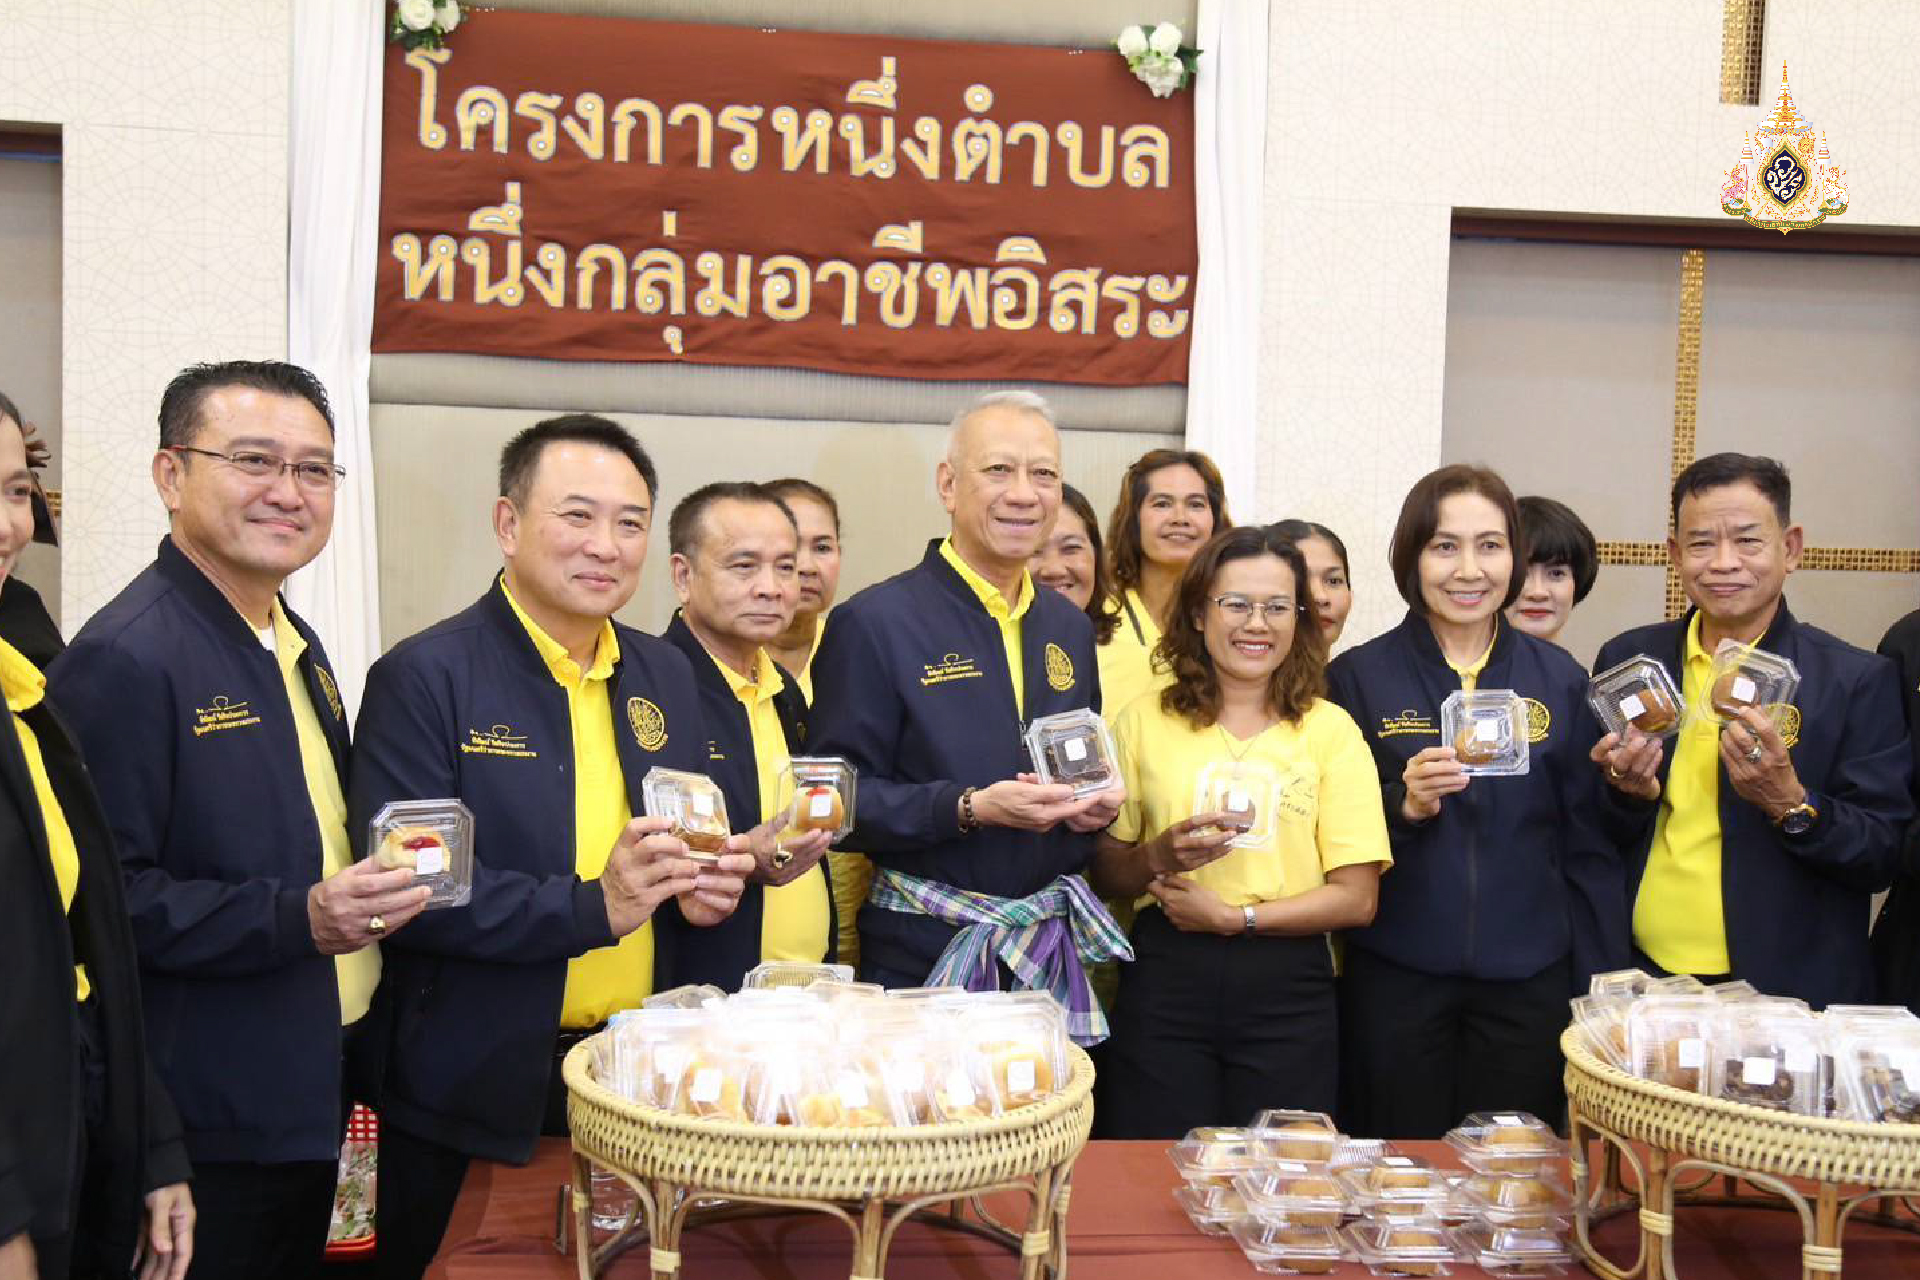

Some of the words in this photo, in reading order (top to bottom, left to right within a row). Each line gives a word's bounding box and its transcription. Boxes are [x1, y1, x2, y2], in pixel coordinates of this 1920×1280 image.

[405, 48, 1170, 188] โครงการหนึ่งตำบล
[392, 182, 1189, 354] หนึ่งกลุ่มอาชีพอิสระ
